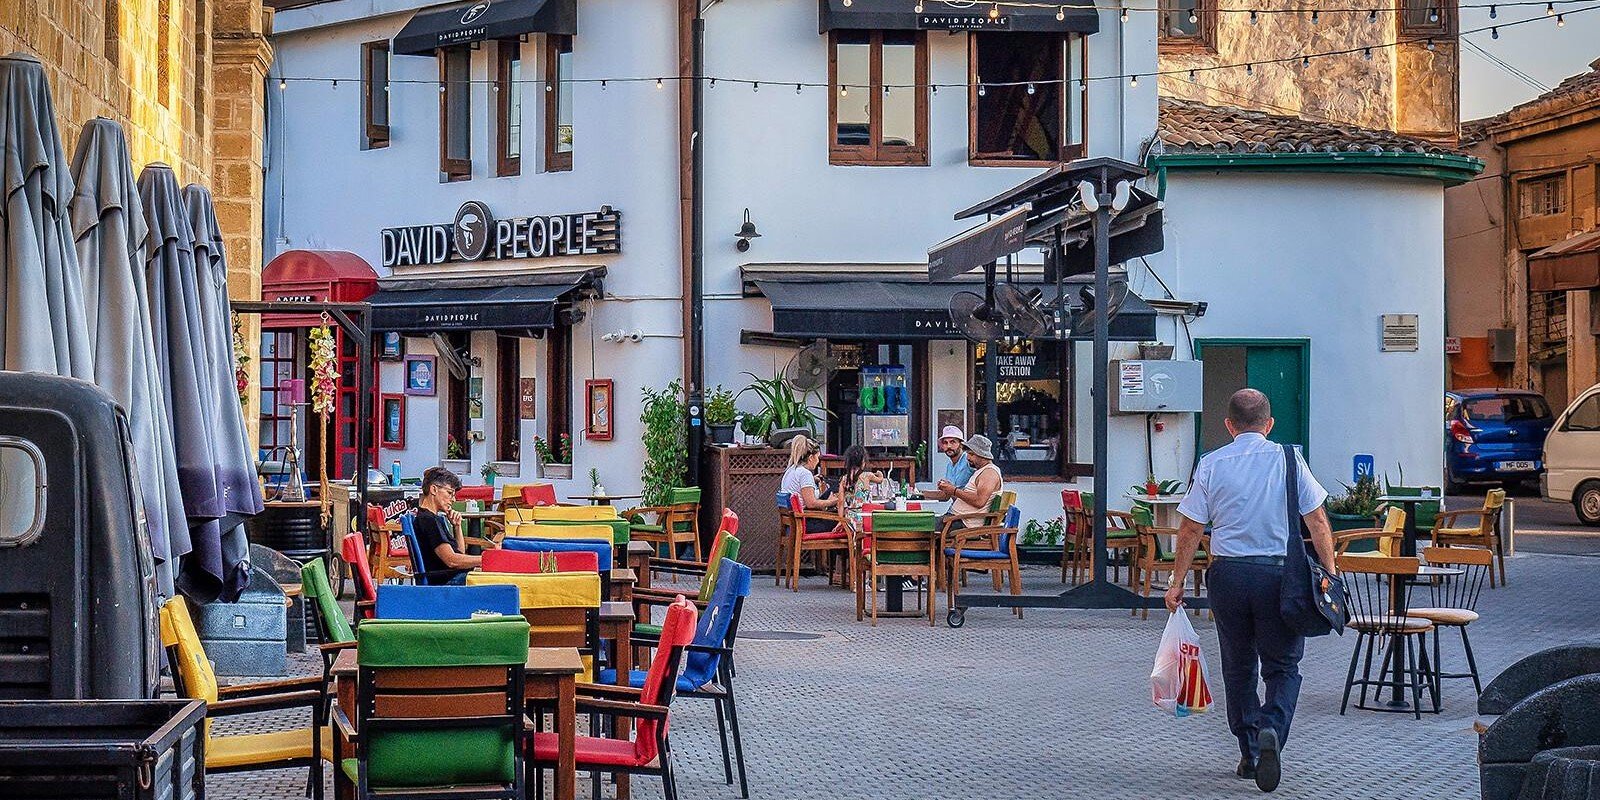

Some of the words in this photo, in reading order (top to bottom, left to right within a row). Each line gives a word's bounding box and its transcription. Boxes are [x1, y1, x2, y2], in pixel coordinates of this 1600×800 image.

[439, 31, 459, 41] DAVID
[381, 227, 448, 267] DAVID
[496, 213, 599, 261] PEOPLE
[995, 355, 1014, 366] TAKE
[1014, 355, 1037, 366] AWAY
[999, 366, 1031, 376] STATION
[1357, 462, 1371, 476] SV
[383, 500, 407, 519] ukta
